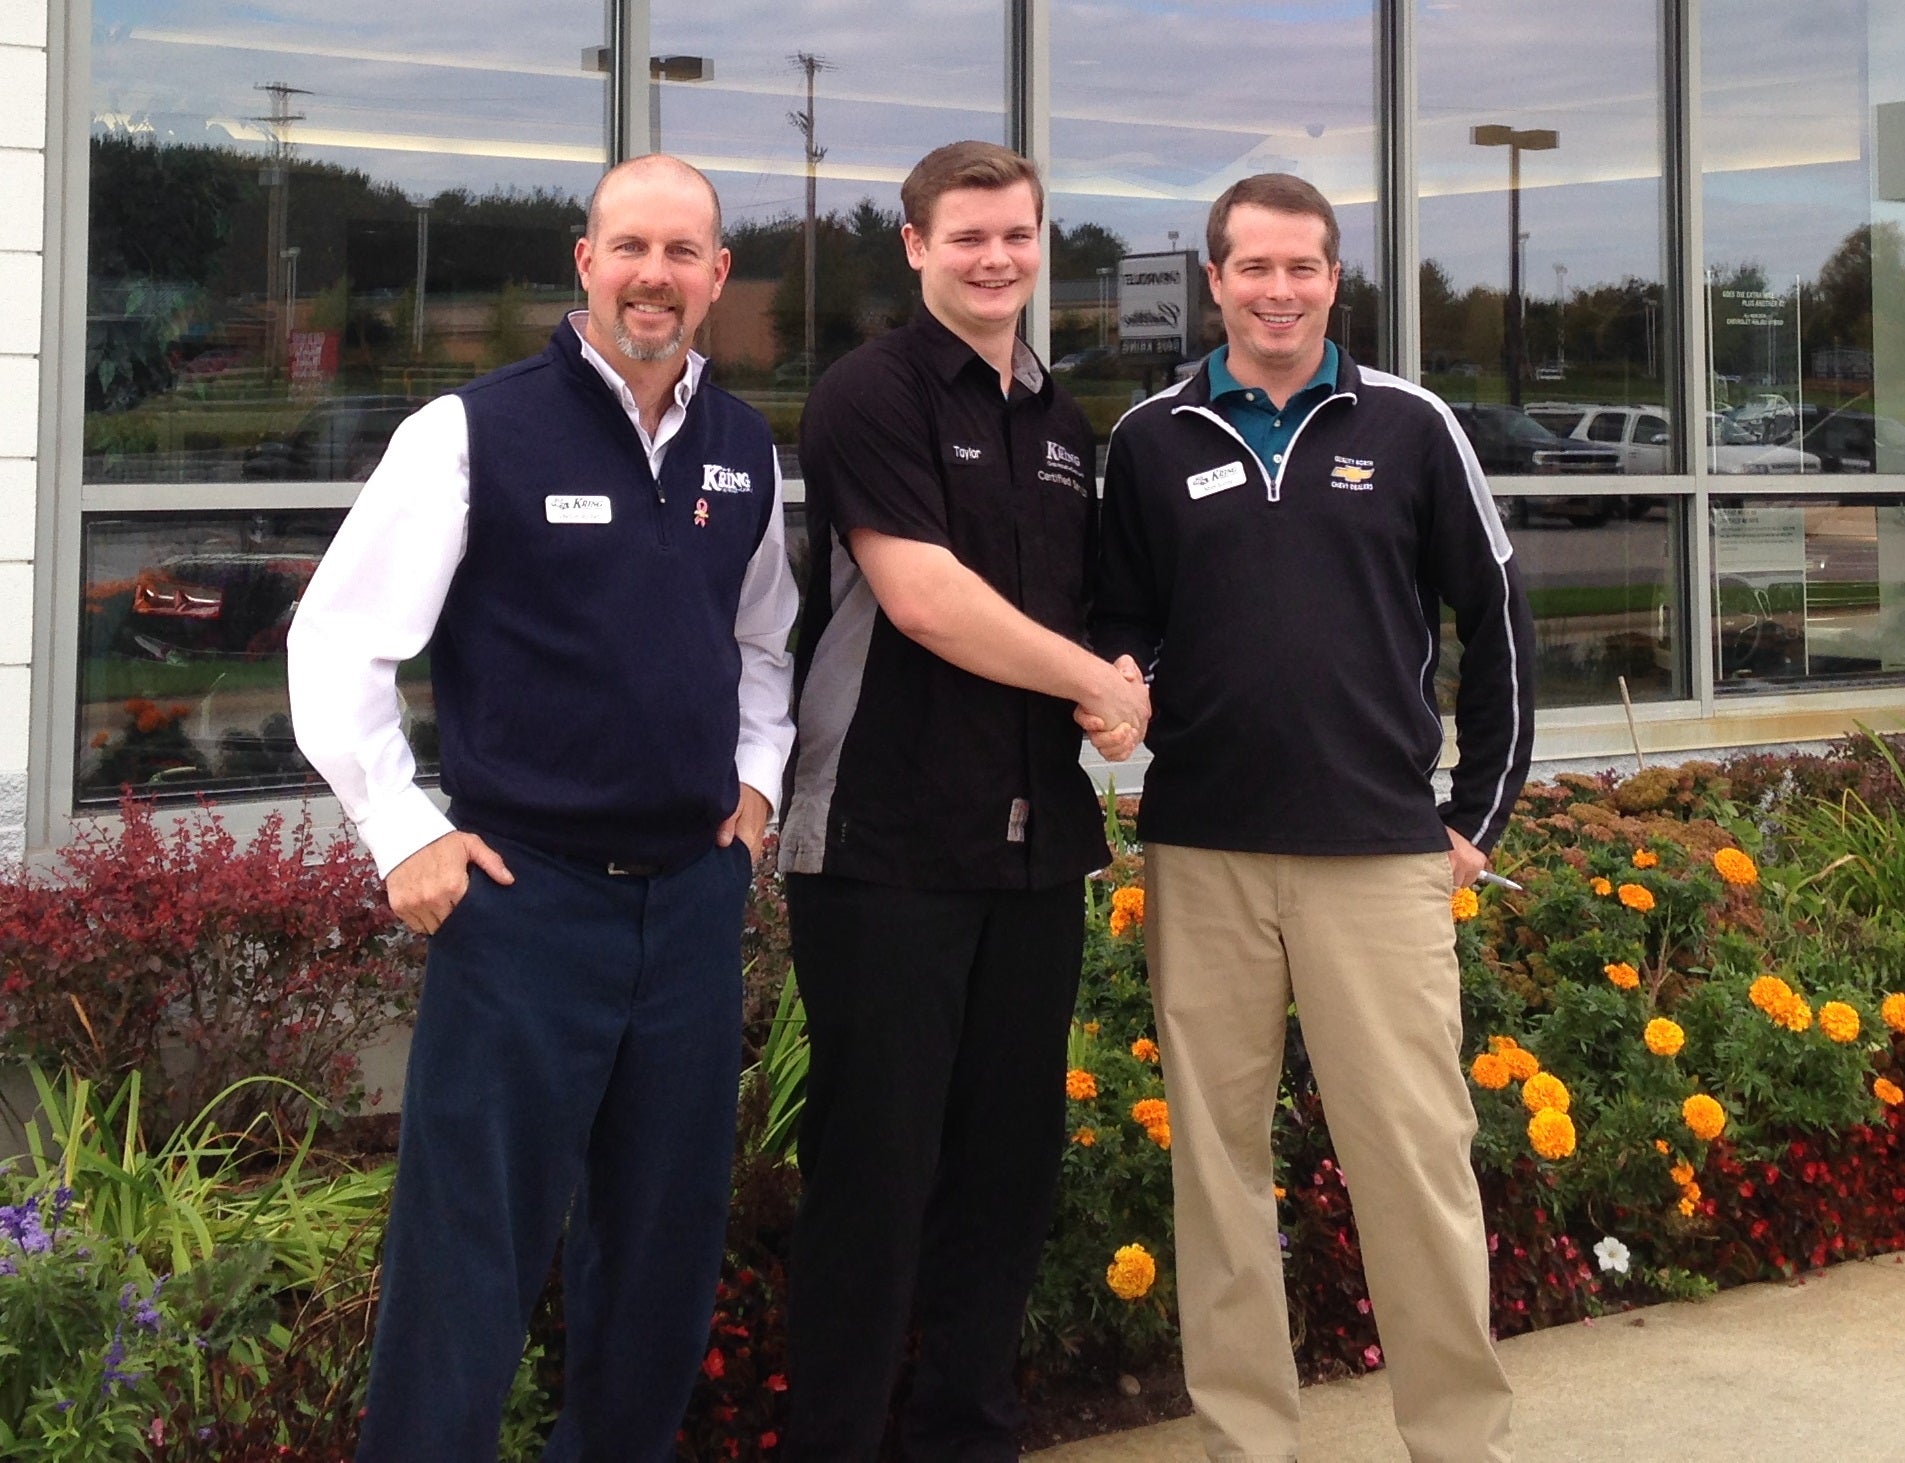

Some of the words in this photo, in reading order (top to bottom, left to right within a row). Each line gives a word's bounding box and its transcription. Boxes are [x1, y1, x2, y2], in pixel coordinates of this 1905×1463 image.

[953, 445, 982, 460] Taylor
[701, 464, 751, 492] KRING
[1037, 470, 1072, 486] Certified
